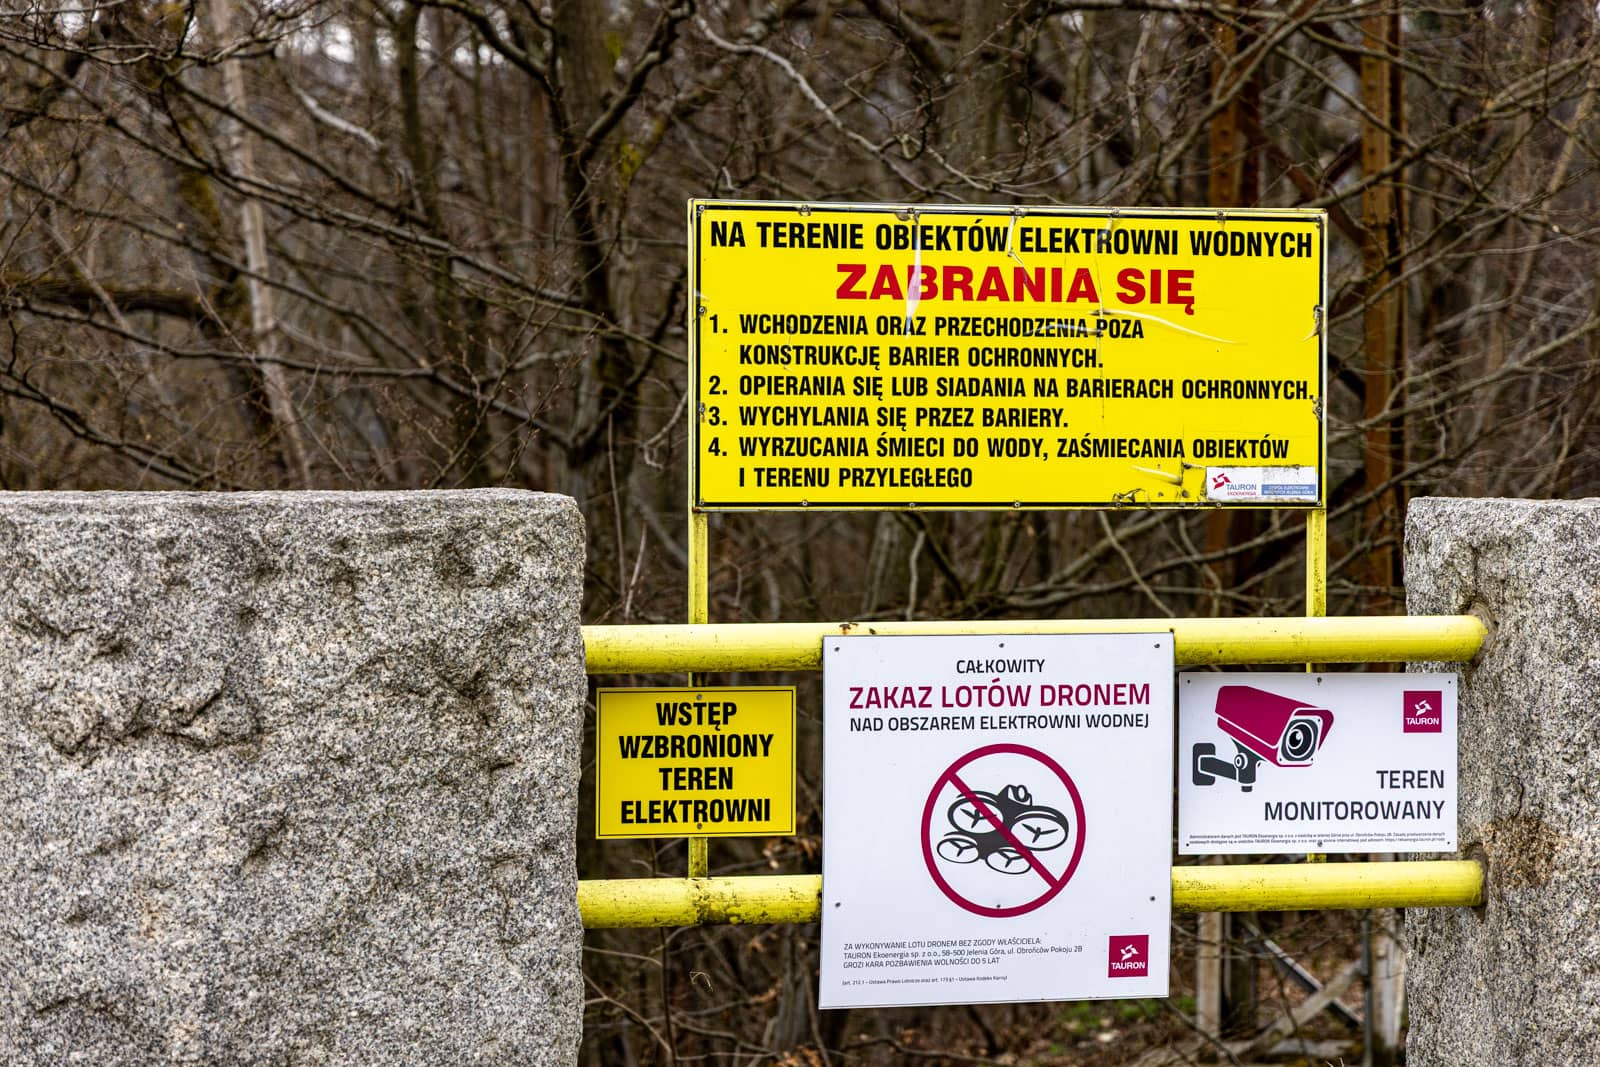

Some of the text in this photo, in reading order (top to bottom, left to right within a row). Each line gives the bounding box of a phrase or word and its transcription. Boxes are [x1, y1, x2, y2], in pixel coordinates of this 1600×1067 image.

[711, 219, 1312, 257] NA TERENIE OBIEKTÓW ELEKTROWNI WODNYCH
[836, 264, 1194, 315] ZABRANIA SIĘ
[709, 314, 1143, 338] 1. WCHODZENIA ORAZ PRZECHODZENIA POZA
[740, 345, 1103, 370] KONSTRUKCJĘ BARIER OCHRONNYCH.
[708, 375, 1314, 401] 2. OPIERANIA SIĘ LUB SIADANIA NA BARIERACH OCHRONNYCH.
[708, 406, 1068, 431] 3. WYCHYLANIA SIĘ PRZEZ BARIERY.
[708, 432, 1289, 461] 4. WYRZUCANIA ŚMIECI DO WODY, ZAŚMIECANIA OBIEKTÓW
[739, 467, 973, 488] I TERENU PRZYLEGŁEGO
[956, 659, 1046, 674] CAŁKOWITY
[849, 677, 1151, 709] ZAKAZ LOTÓW DRONEM
[656, 702, 737, 731] WSTĘP
[849, 713, 1149, 732] NAD OBSZAREM ELEKTROWNI WODNEJ
[1405, 717, 1439, 725] TAURON
[619, 734, 774, 759] WZBRONIONY
[659, 767, 733, 790] TEREN
[1376, 770, 1445, 789] TEREN
[621, 798, 770, 824] ELEKTROWNI
[1264, 800, 1445, 821] MONITOROWANY
[843, 952, 872, 960] TAURON
[873, 951, 909, 960] Ekoenergia
[966, 948, 988, 956] Jelenia
[1016, 946, 1049, 954] Obrońców
[1050, 946, 1073, 954] Pokoju
[855, 942, 907, 950] WYKONYWANIE
[927, 940, 957, 948] DRONEM
[843, 961, 864, 969] GROZI
[865, 960, 884, 968] KARA
[885, 959, 933, 968] POZBAWIENIA
[934, 957, 969, 966] WOLNOŚCI
[970, 957, 981, 965] DO
[988, 956, 1000, 964] LAT
[1111, 961, 1146, 970] TAURON
